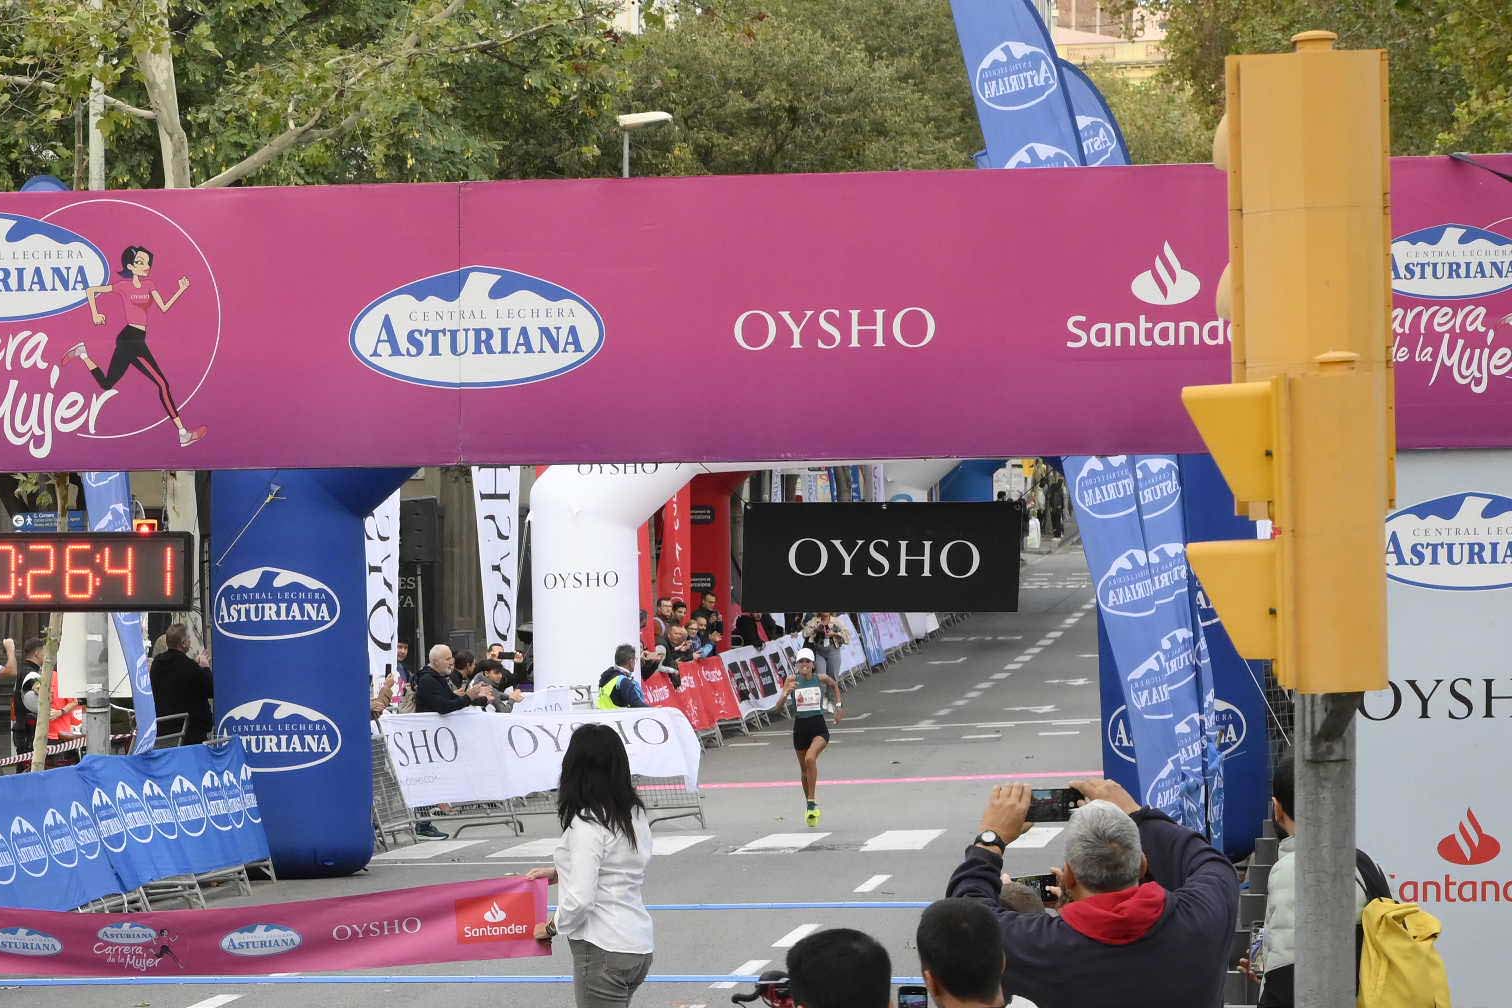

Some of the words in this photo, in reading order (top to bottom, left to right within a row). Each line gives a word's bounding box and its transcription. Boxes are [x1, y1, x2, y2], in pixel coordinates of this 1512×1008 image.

[12, 250, 84, 261] LECHERA
[409, 309, 488, 322] CENTRAL
[495, 307, 577, 320] LECHERA
[1392, 304, 1487, 334] arrera
[370, 313, 585, 358] ASTURIANA
[733, 307, 936, 351] OYSHO
[1066, 315, 1233, 348] Santand
[1415, 335, 1433, 362] la
[1412, 527, 1480, 537] CENTRAL
[787, 538, 981, 578] OYSHO
[543, 570, 619, 590] OYSHO
[231, 592, 273, 600] CENTRAL
[277, 591, 326, 599] LECHERA
[218, 597, 331, 624] ASTURIANA
[102, 931, 153, 939] ASTURIANA
[332, 916, 422, 941] OYSHO
[464, 923, 529, 938] Santander
[93, 943, 143, 955] Carrera
[227, 936, 297, 951] ASTURIANA
[125, 953, 163, 971] Mujer
